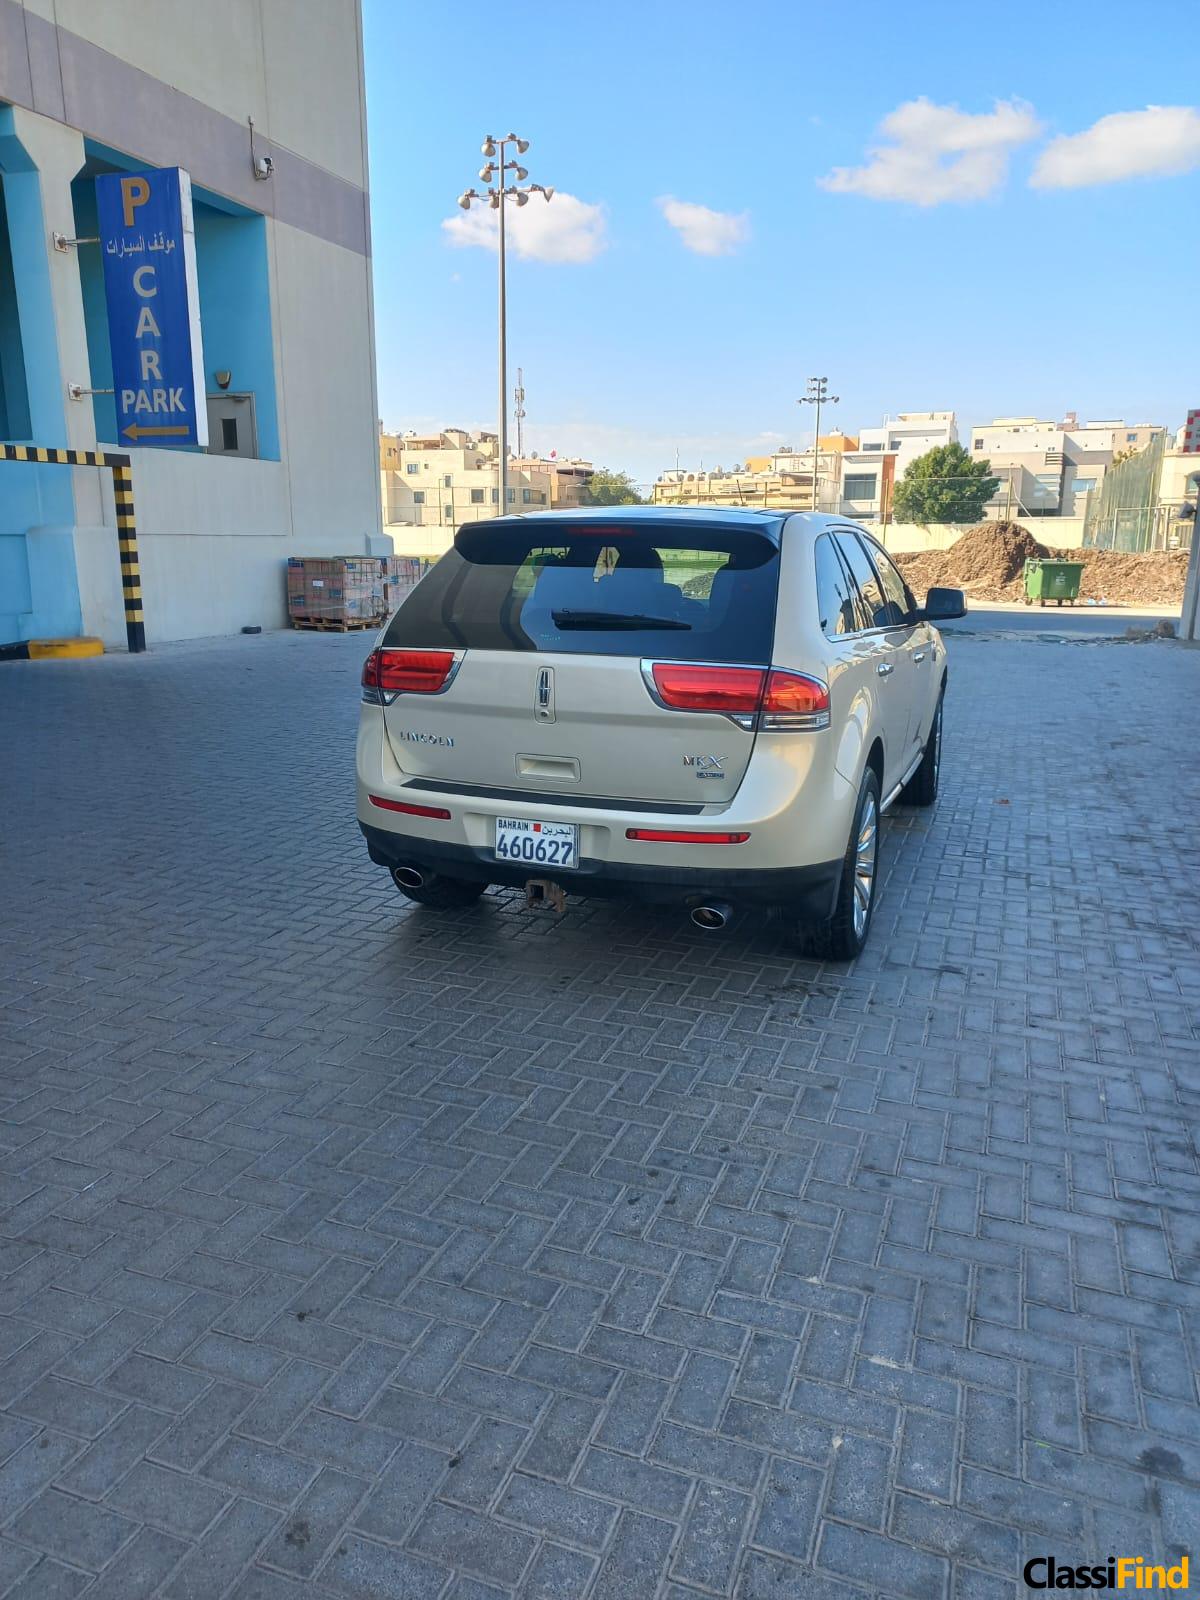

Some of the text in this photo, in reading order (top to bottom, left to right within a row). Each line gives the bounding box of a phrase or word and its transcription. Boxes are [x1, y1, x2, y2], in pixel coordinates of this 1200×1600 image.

[120, 177, 151, 226] P
[106, 232, 176, 258] موقف السيارات
[132, 265, 163, 381] CAR
[121, 387, 187, 414] PARK
[400, 731, 454, 747] LINCOLN
[683, 755, 729, 770] MKX
[498, 819, 529, 832] BAHRAIN
[497, 834, 573, 865] 460627
